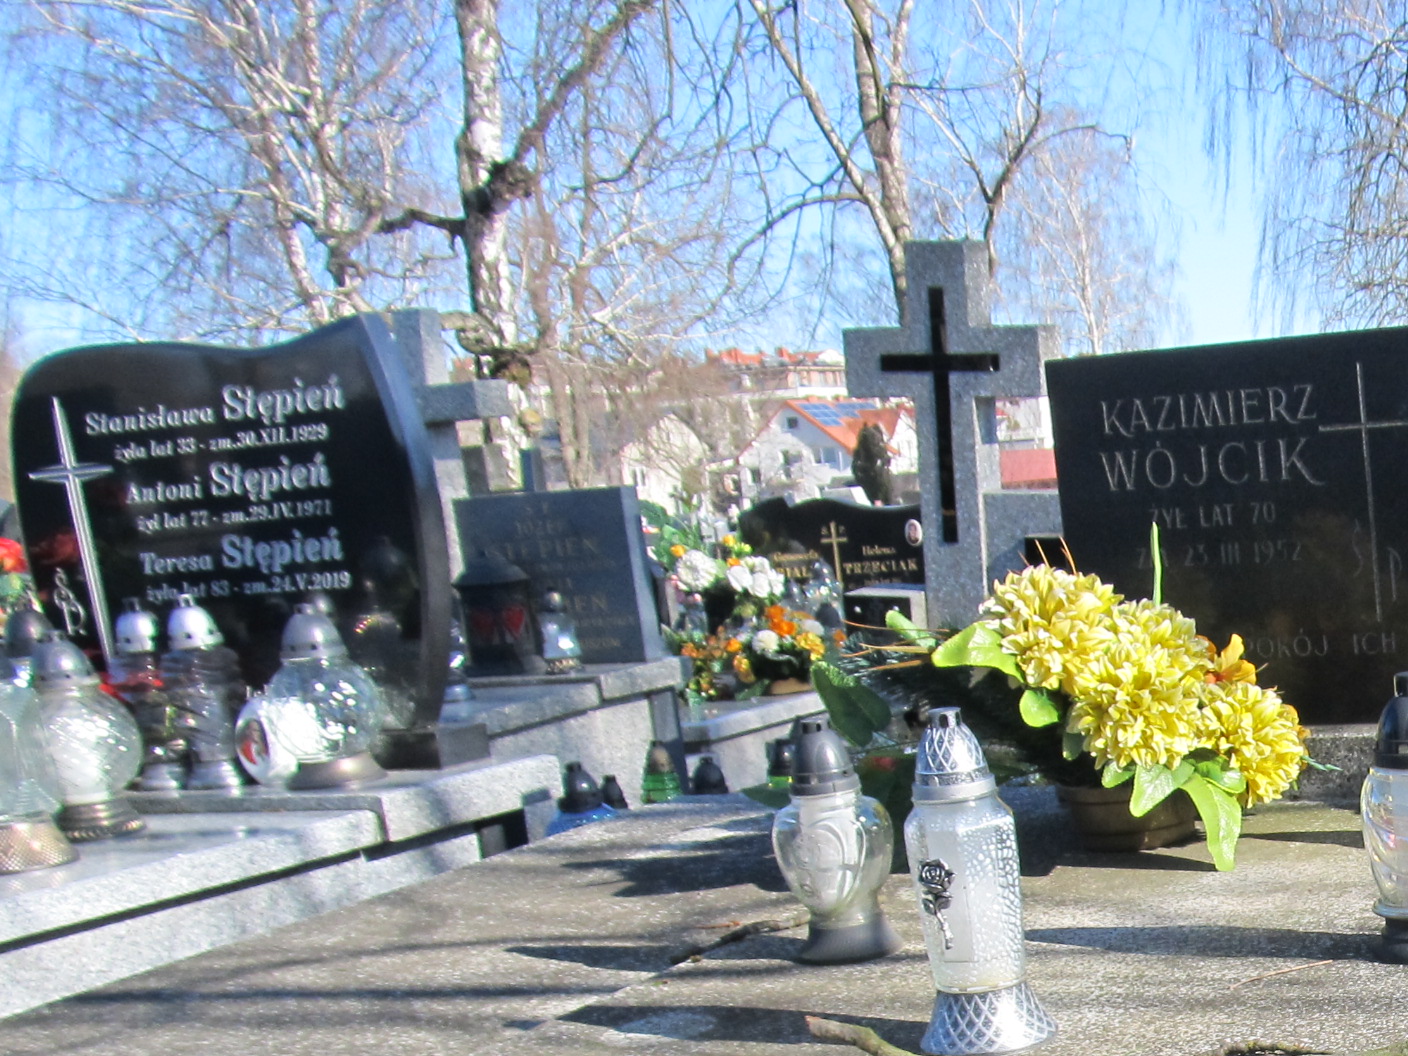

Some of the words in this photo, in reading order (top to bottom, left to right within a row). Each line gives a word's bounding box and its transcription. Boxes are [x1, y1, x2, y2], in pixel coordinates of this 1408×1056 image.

[84, 404, 217, 437] Stanisława
[221, 373, 346, 425] Stępień
[1100, 383, 1318, 438] KAZIMIERZ
[150, 439, 174, 459] lat
[177, 436, 199, 456] 33
[1099, 435, 1328, 492] WÓJCIK
[125, 475, 205, 505] Antoni
[208, 451, 332, 502] Stępień
[164, 511, 188, 529] lat
[1199, 502, 1235, 528] LAT
[1249, 501, 1276, 525] 70
[139, 550, 215, 576] Teresa
[221, 525, 345, 575] Stępień
[842, 557, 919, 575] TRZECIAK
[1352, 632, 1396, 656] ICH
